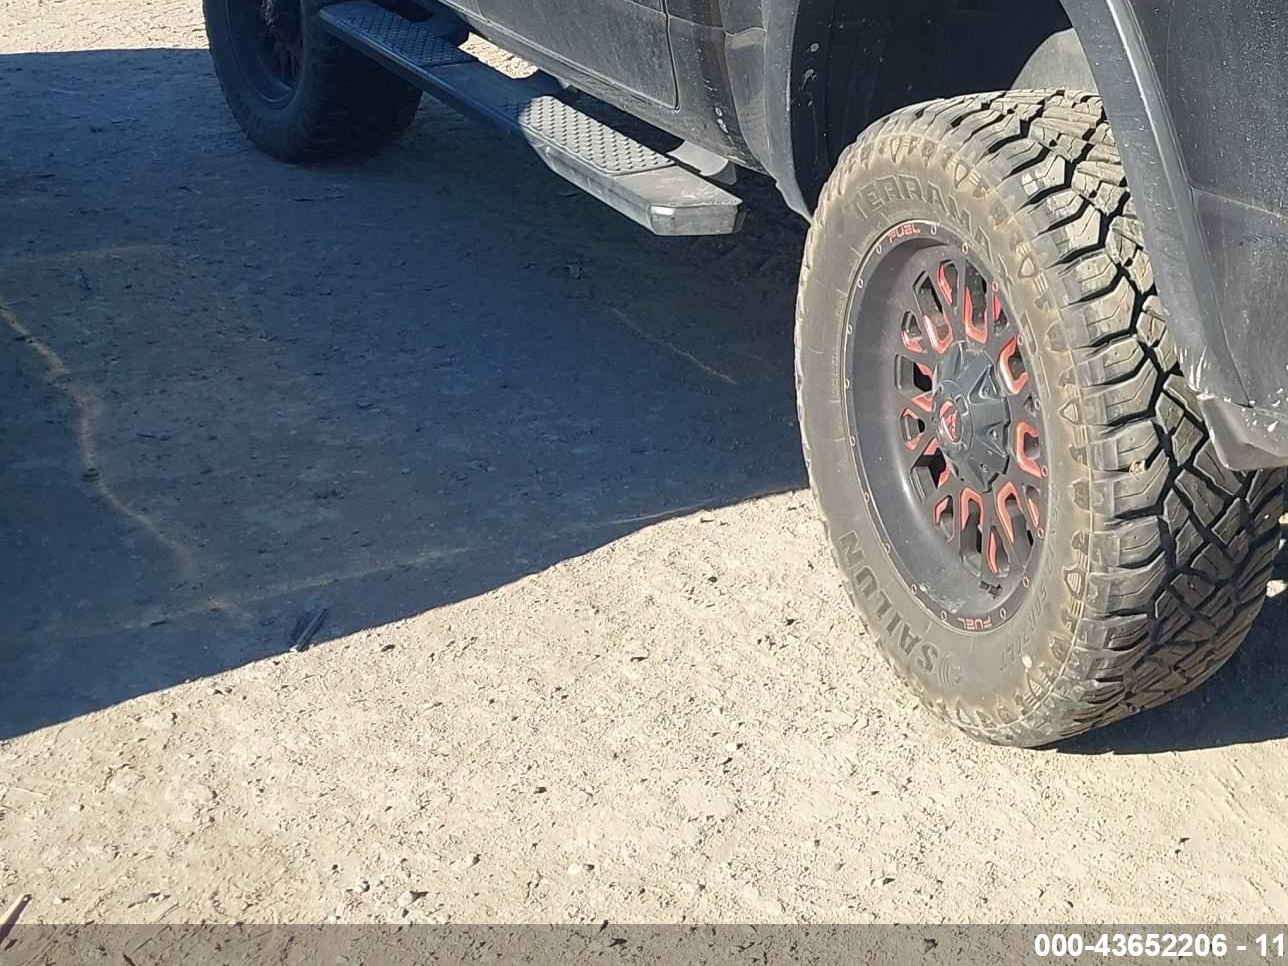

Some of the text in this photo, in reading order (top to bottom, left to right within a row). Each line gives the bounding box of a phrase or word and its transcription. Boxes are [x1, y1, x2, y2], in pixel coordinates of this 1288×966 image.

[887, 223, 921, 243] FUEL
[839, 529, 939, 674] SAILUN
[957, 616, 993, 631] FUEL
